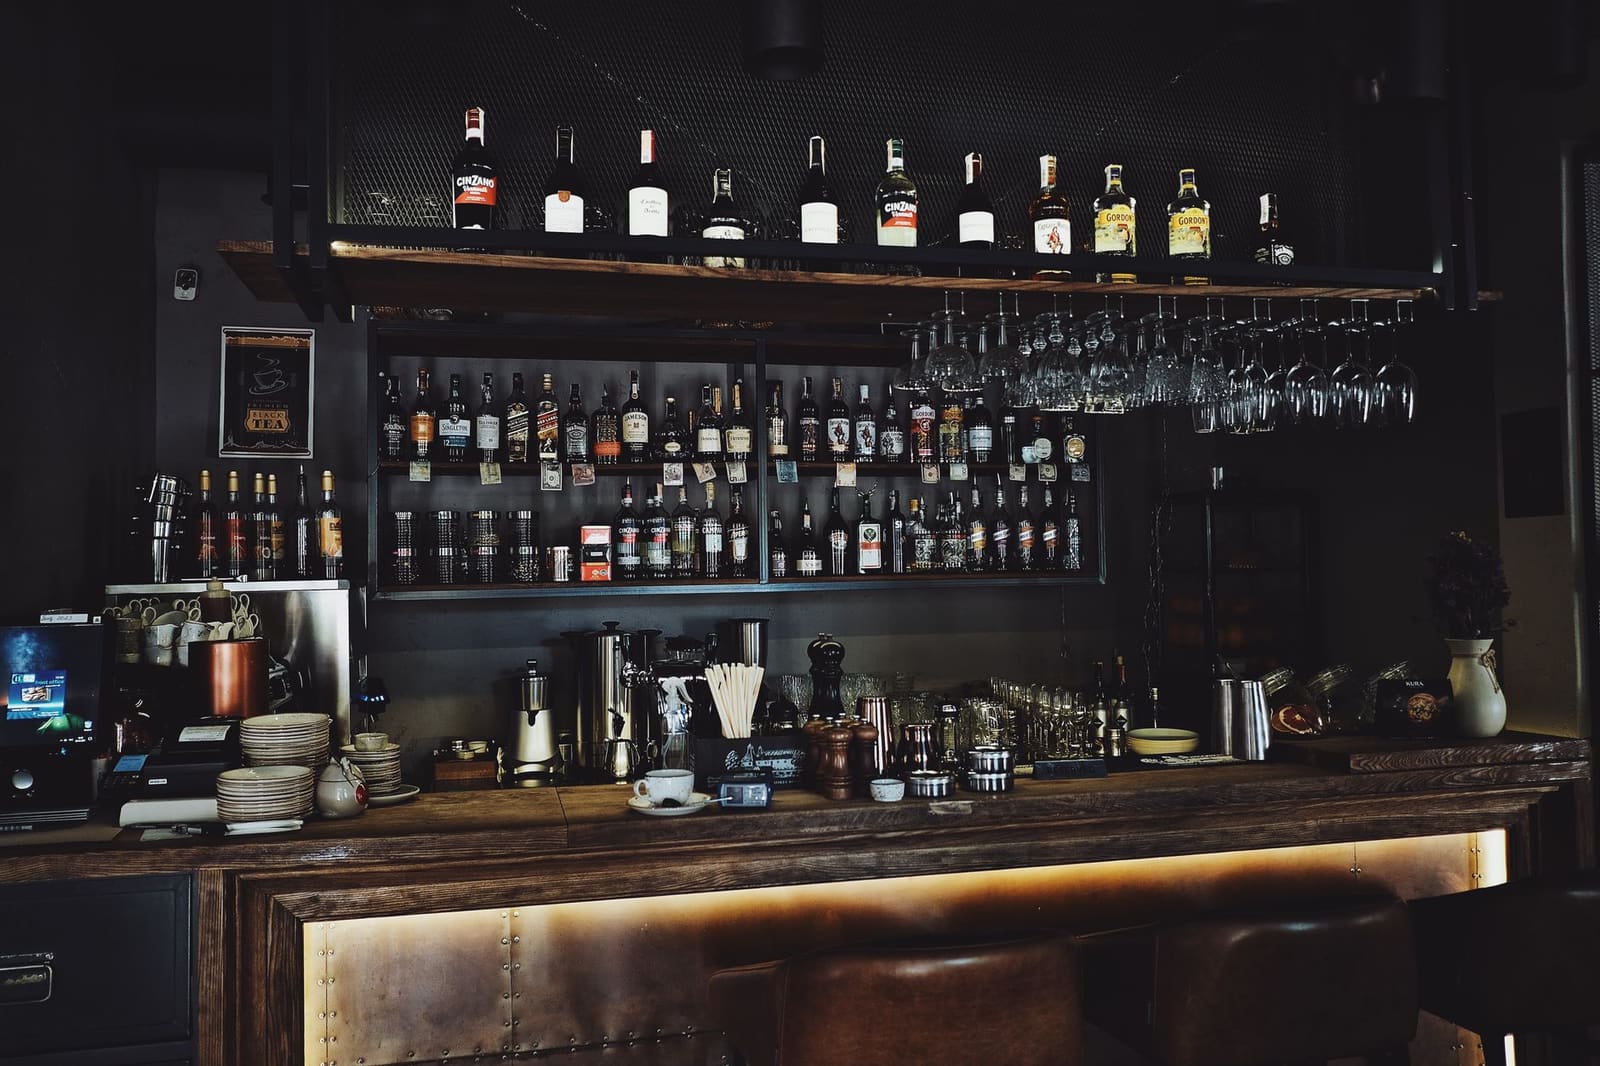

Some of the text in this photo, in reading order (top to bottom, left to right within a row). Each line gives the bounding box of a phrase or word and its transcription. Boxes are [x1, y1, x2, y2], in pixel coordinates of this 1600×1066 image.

[456, 175, 495, 189] CINZANO
[624, 412, 647, 422] JAMESON
[252, 418, 284, 429] TEA
